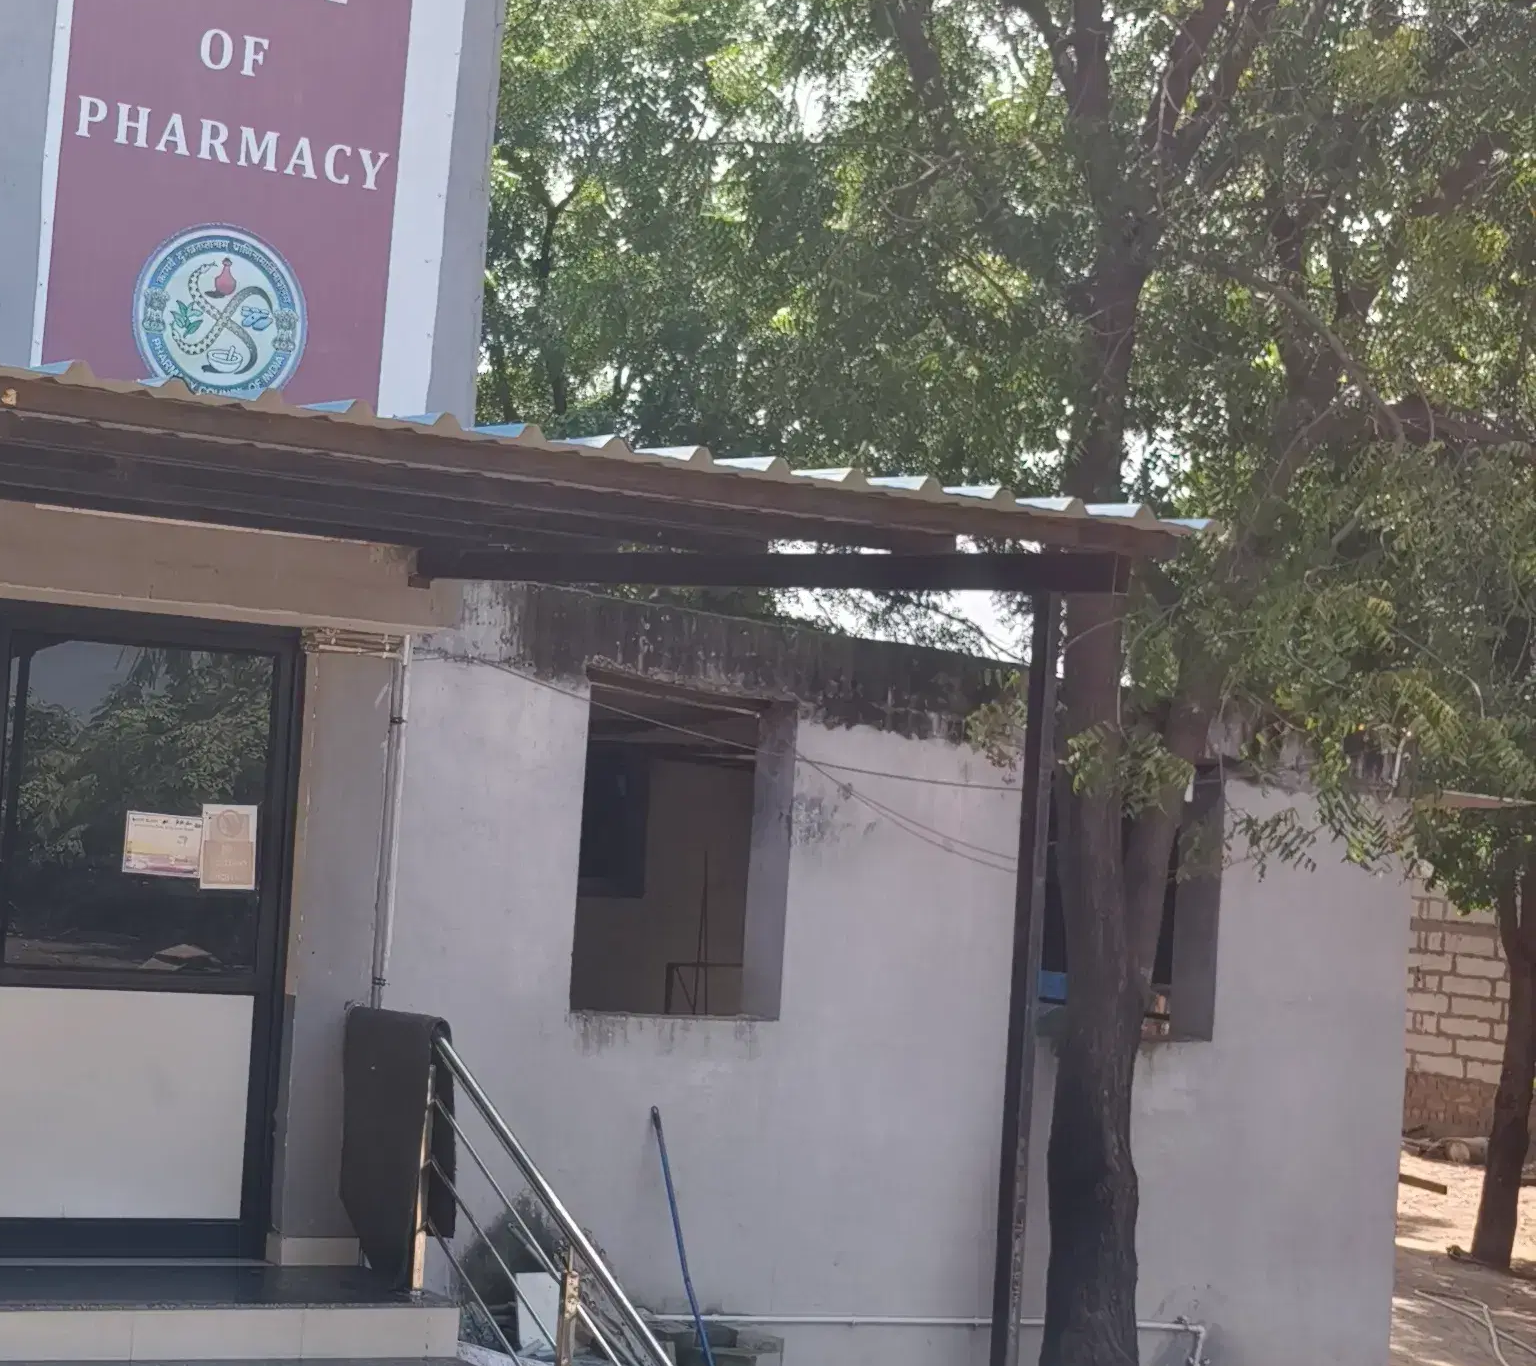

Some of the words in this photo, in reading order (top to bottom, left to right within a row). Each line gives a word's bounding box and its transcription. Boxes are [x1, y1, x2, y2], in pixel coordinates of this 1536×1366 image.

[199, 27, 271, 78] OF
[75, 95, 391, 192] PHARMACY
[151, 337, 199, 391] PHARMY
